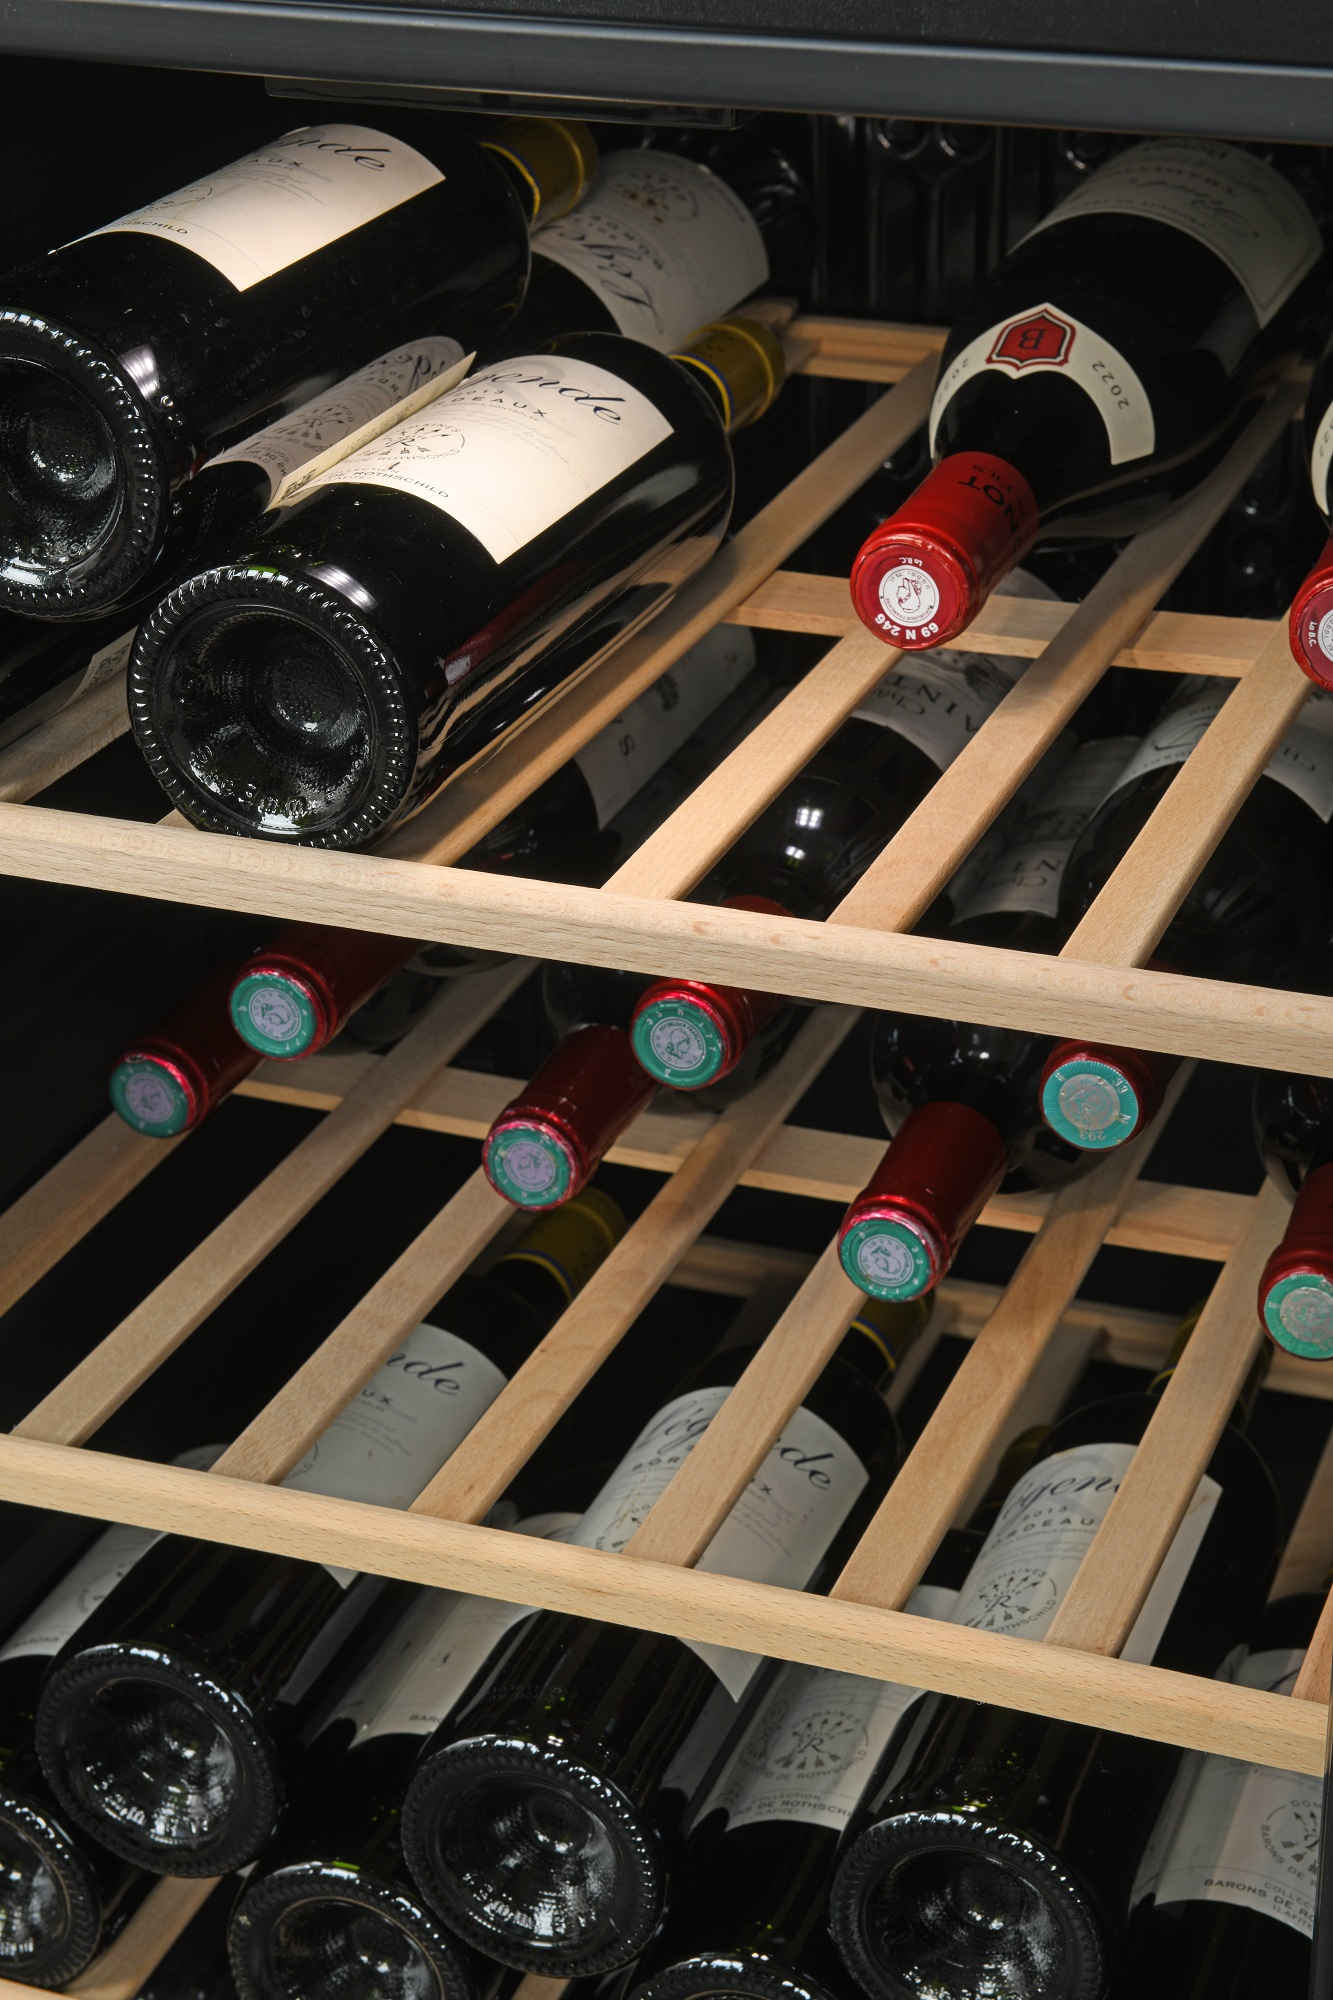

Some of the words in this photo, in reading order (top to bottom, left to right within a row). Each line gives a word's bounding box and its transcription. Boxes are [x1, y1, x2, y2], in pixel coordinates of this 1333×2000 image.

[1018, 328, 1047, 350] B
[1091, 360, 1131, 411] 2022
[353, 470, 450, 498] ROTHSCHILD
[874, 613, 901, 636] 246
[905, 629, 917, 640] N
[920, 622, 939, 637] 69
[1260, 1823, 1285, 1864] BARONS
[1286, 1864, 1306, 1882] DE
[1203, 1877, 1268, 1899] BARONS
[1272, 1894, 1297, 1912] DE
[1263, 1879, 1317, 1911] COLLEC
